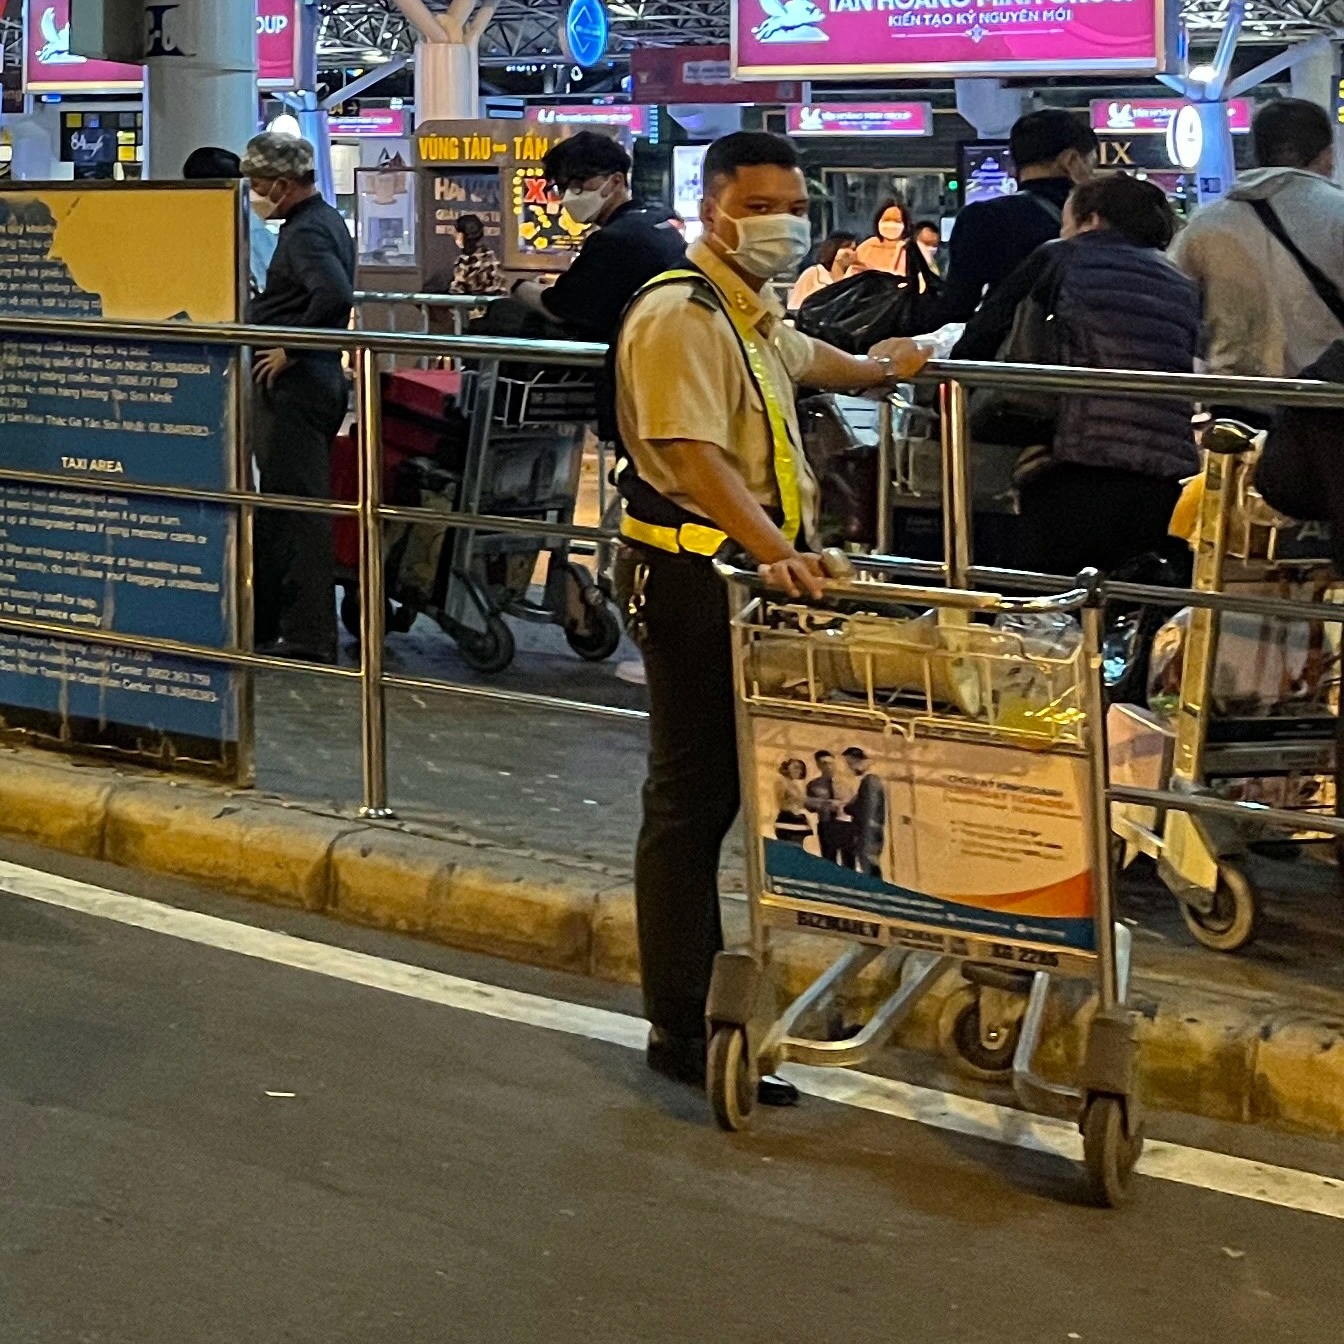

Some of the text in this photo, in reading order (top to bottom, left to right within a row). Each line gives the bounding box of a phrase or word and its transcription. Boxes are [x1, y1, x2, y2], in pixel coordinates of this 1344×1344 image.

[418, 132, 460, 161] VŨNG
[462, 132, 491, 161] TÀU
[60, 455, 124, 474] TAXI AREA
